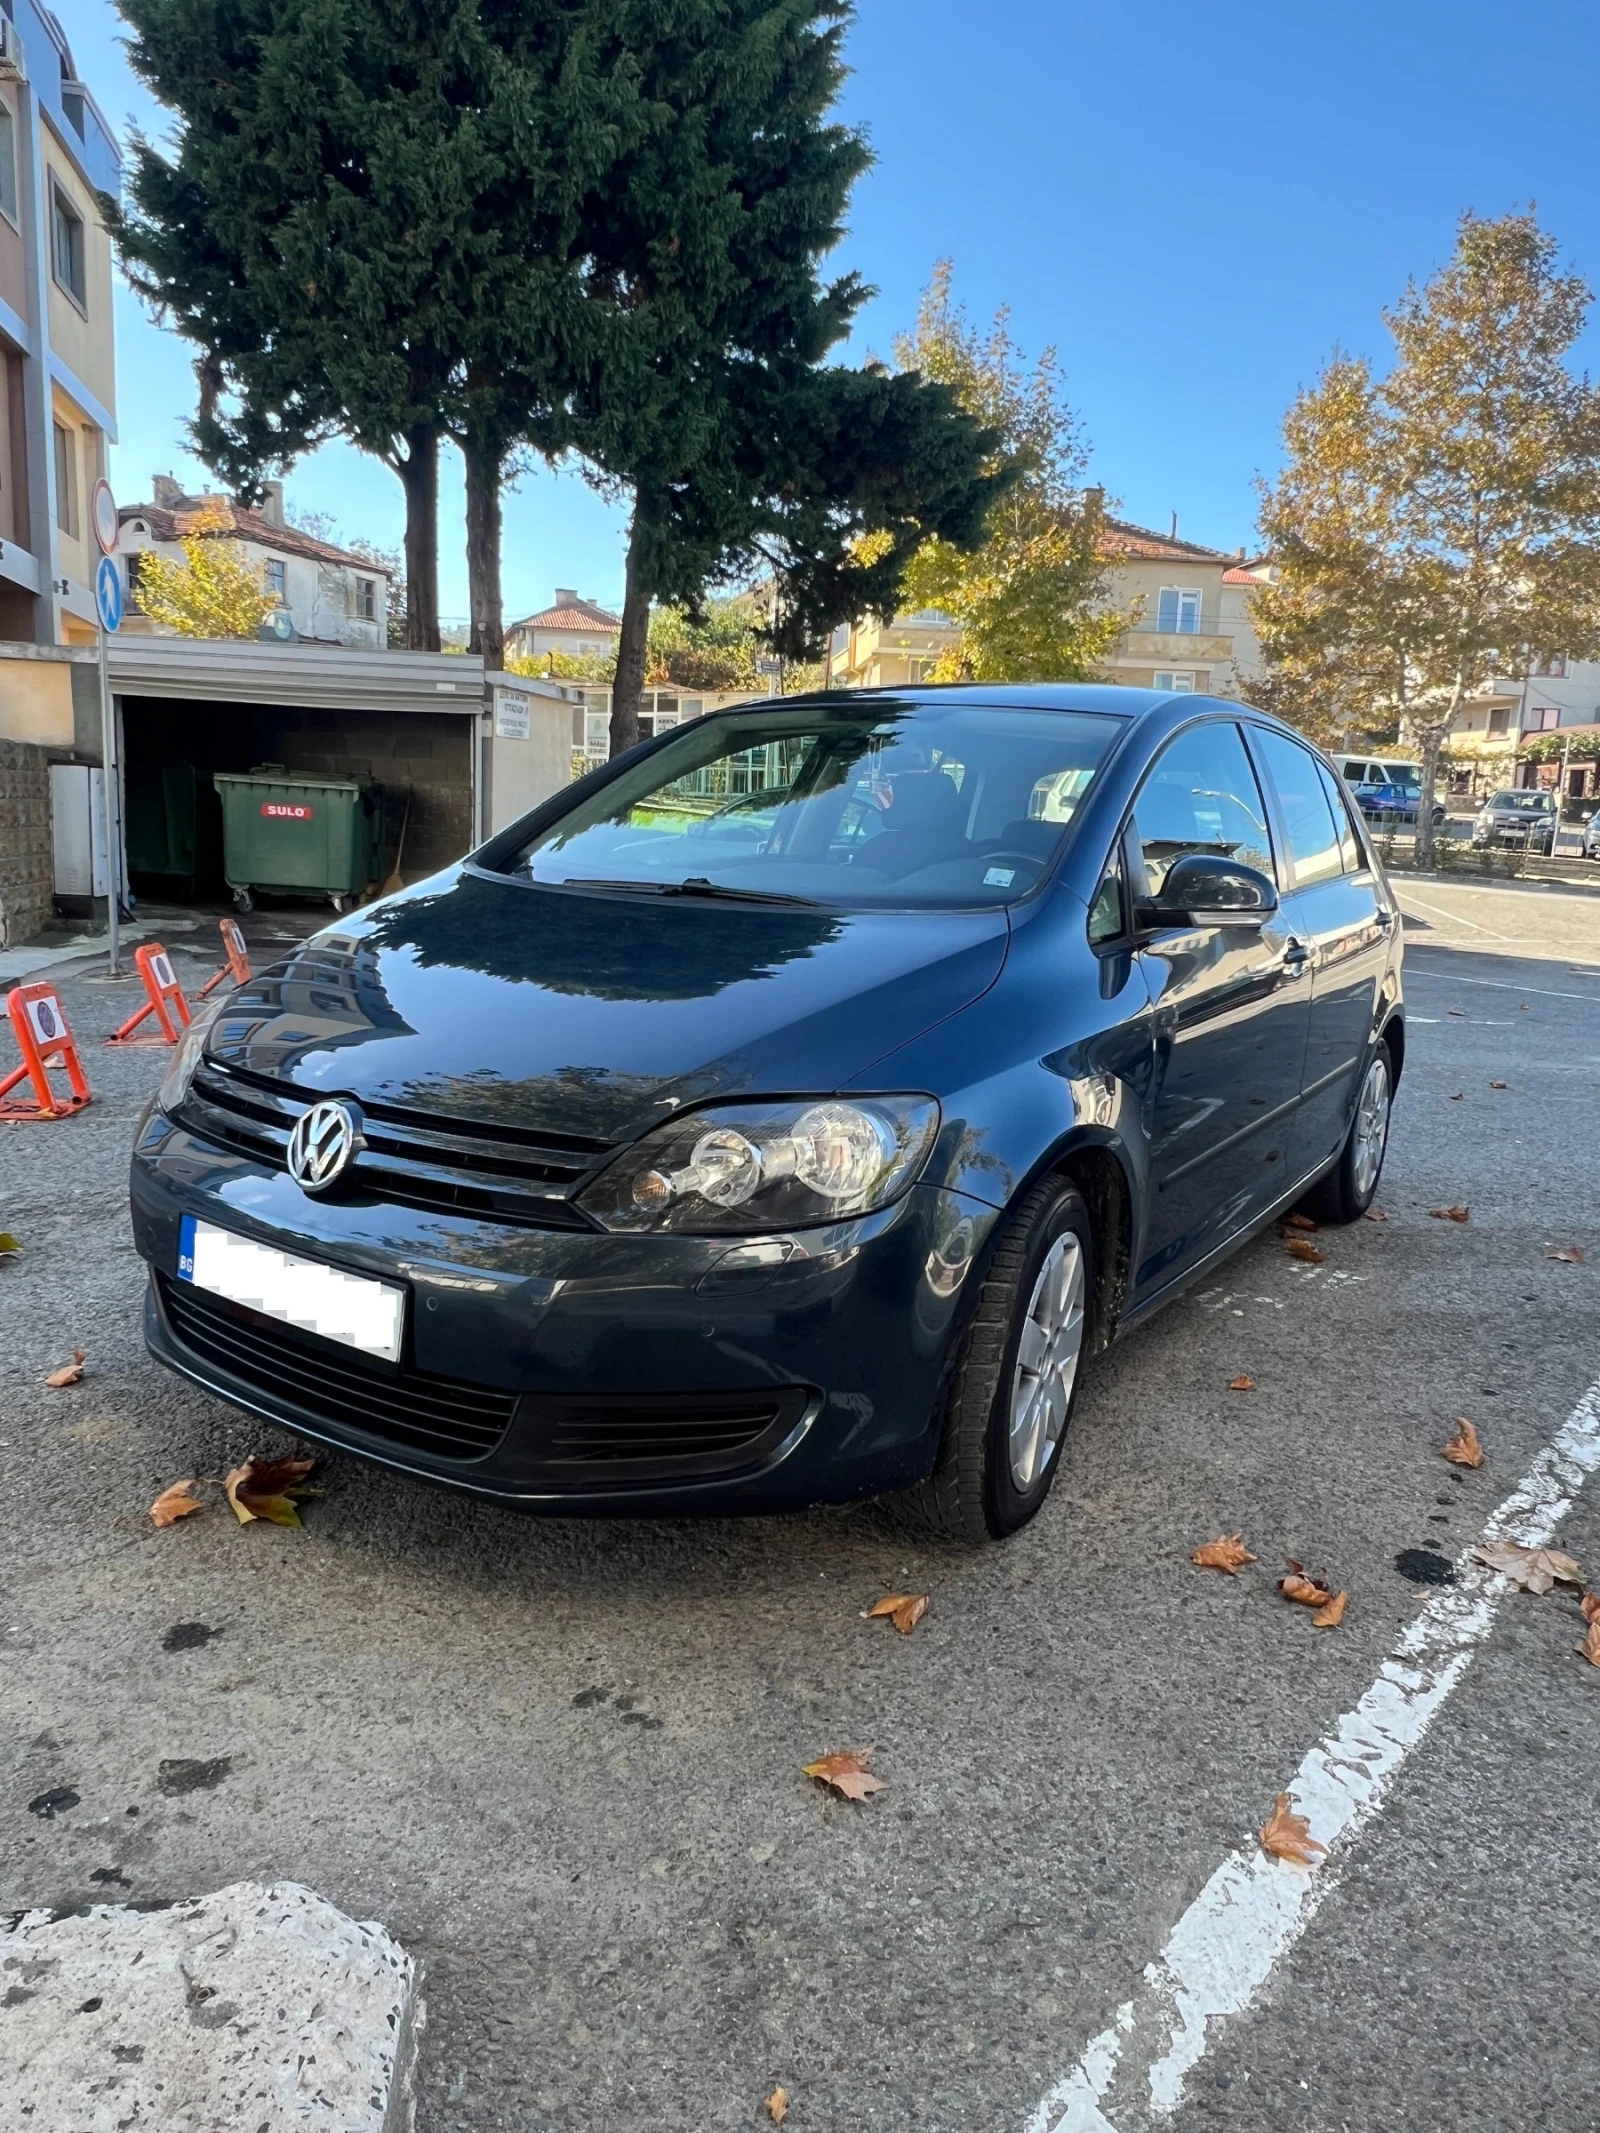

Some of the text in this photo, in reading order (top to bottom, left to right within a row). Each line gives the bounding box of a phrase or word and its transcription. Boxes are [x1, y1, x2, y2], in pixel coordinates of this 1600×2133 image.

[267, 805, 305, 817] SULO
[289, 1104, 350, 1186] VW
[179, 1254, 193, 1273] BG
